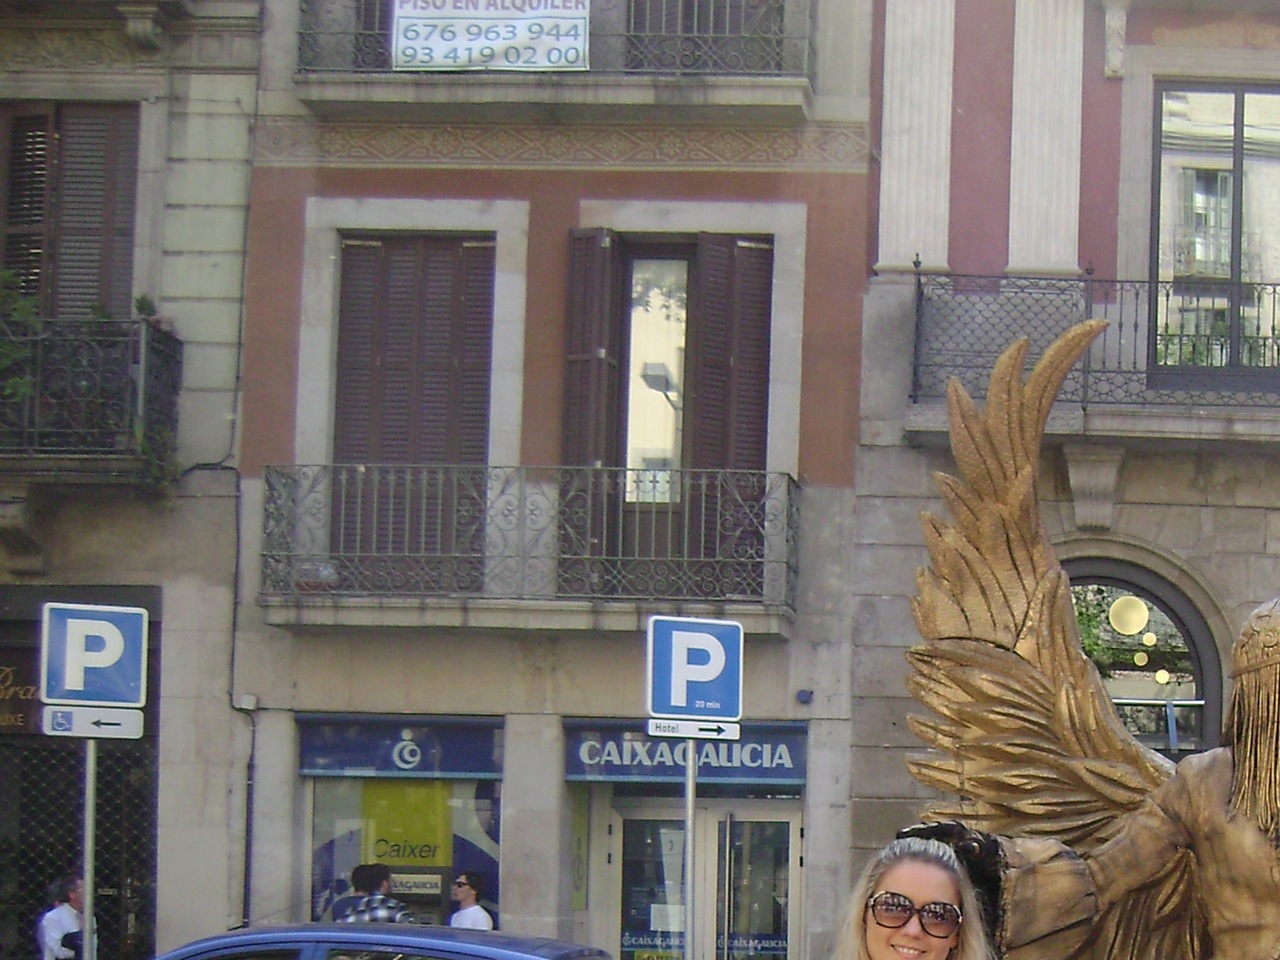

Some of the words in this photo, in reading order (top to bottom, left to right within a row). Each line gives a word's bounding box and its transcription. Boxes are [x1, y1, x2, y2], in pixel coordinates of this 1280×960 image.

[399, 0, 447, 10] PISO
[452, 0, 479, 10] EN
[485, 0, 587, 13] ALQUILER
[402, 24, 457, 42] 676
[466, 24, 518, 42] 963
[527, 22, 581, 42] 944
[402, 46, 434, 64] 93
[443, 47, 496, 64] 419
[504, 46, 538, 64] 02
[546, 47, 580, 64] 00
[65, 618, 125, 691] P
[671, 630, 726, 707] P
[655, 722, 680, 733] Hotel
[373, 837, 441, 859] Caixer
